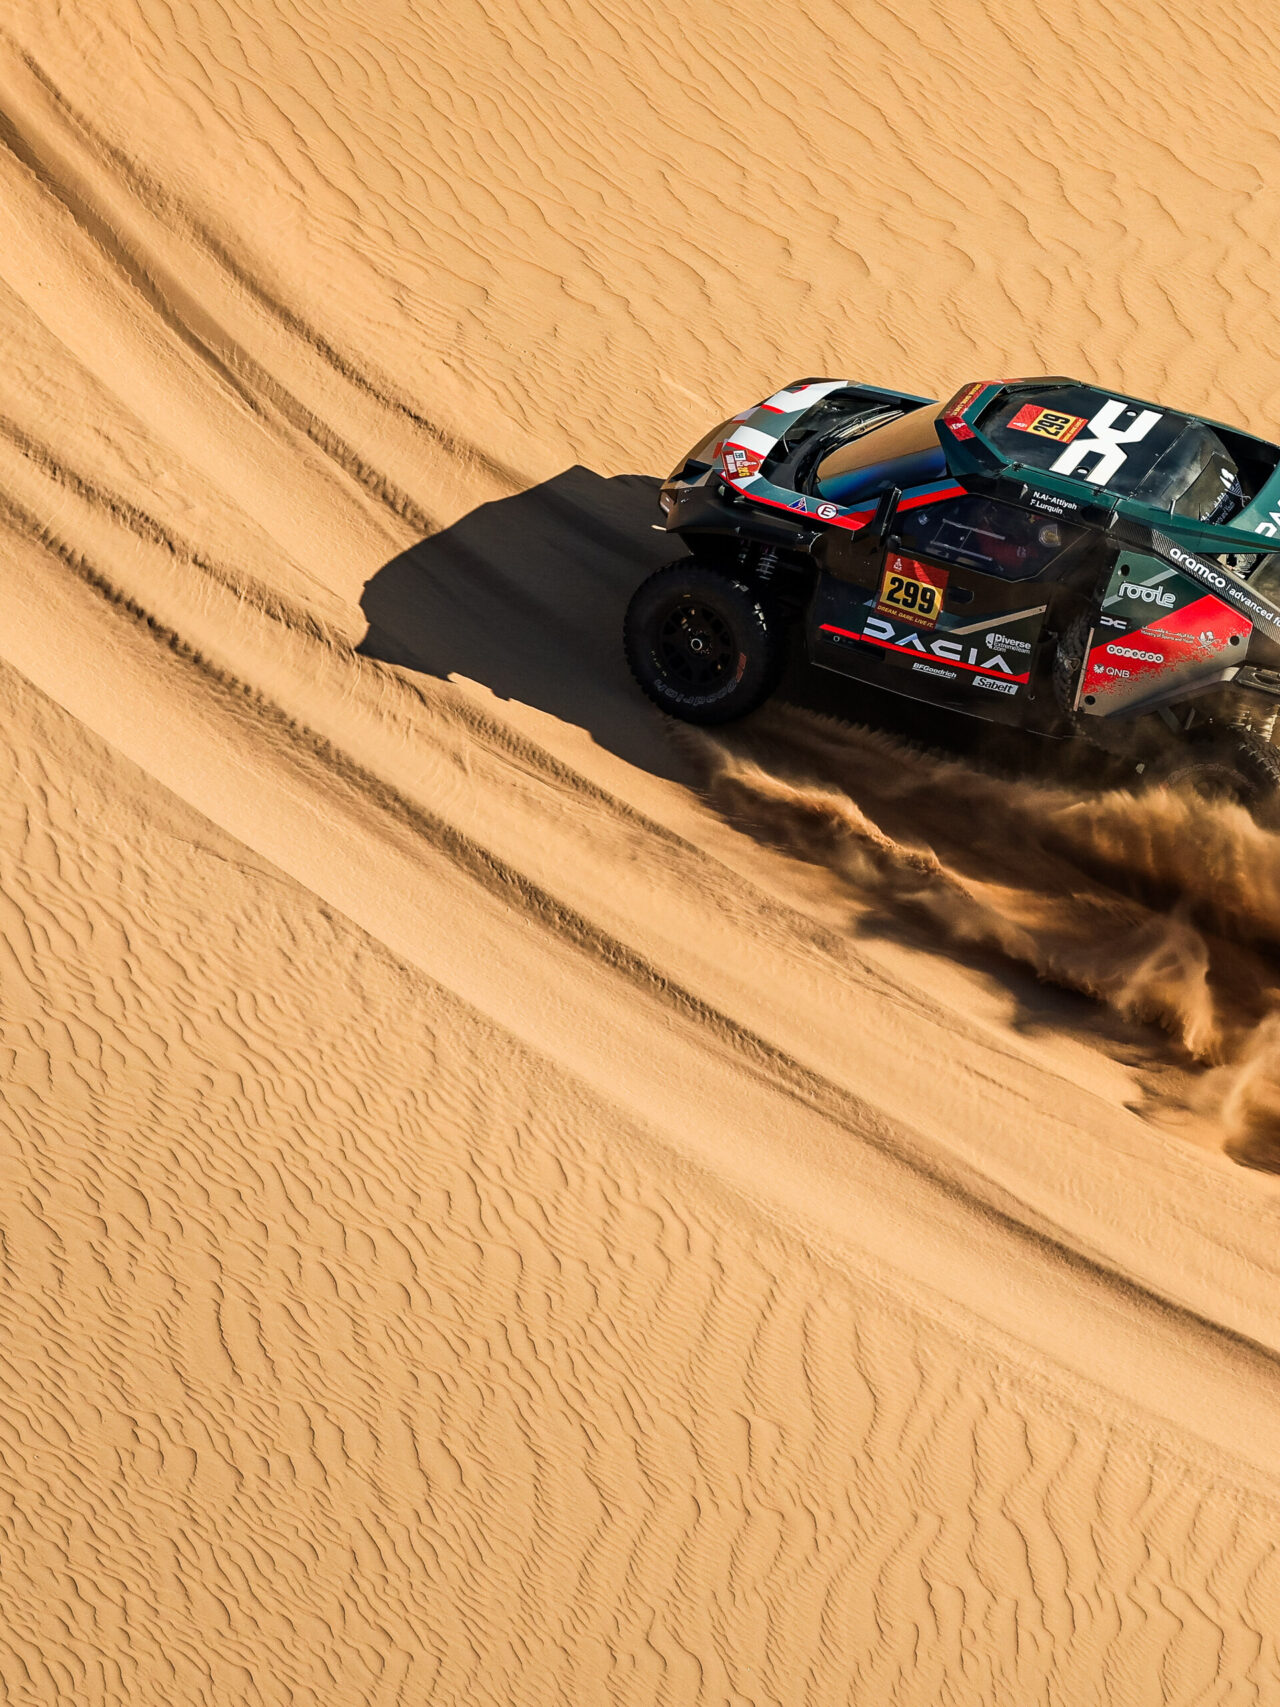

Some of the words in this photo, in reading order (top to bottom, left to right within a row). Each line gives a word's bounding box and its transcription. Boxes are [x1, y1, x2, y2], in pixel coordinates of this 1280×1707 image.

[1033, 413, 1071, 437] 299
[1033, 491, 1078, 510] N.Al-Attiyah
[1118, 580, 1176, 608] roole
[1169, 548, 1226, 588] aramco
[1229, 588, 1274, 621] advanced
[886, 576, 936, 615] 299
[862, 616, 1014, 675] DACIA
[994, 633, 1032, 650] Diverse
[1107, 645, 1163, 663] ooredoo
[913, 662, 957, 679] BFGoodrich
[1106, 667, 1130, 678] QNB
[977, 677, 1014, 693] Sabelt
